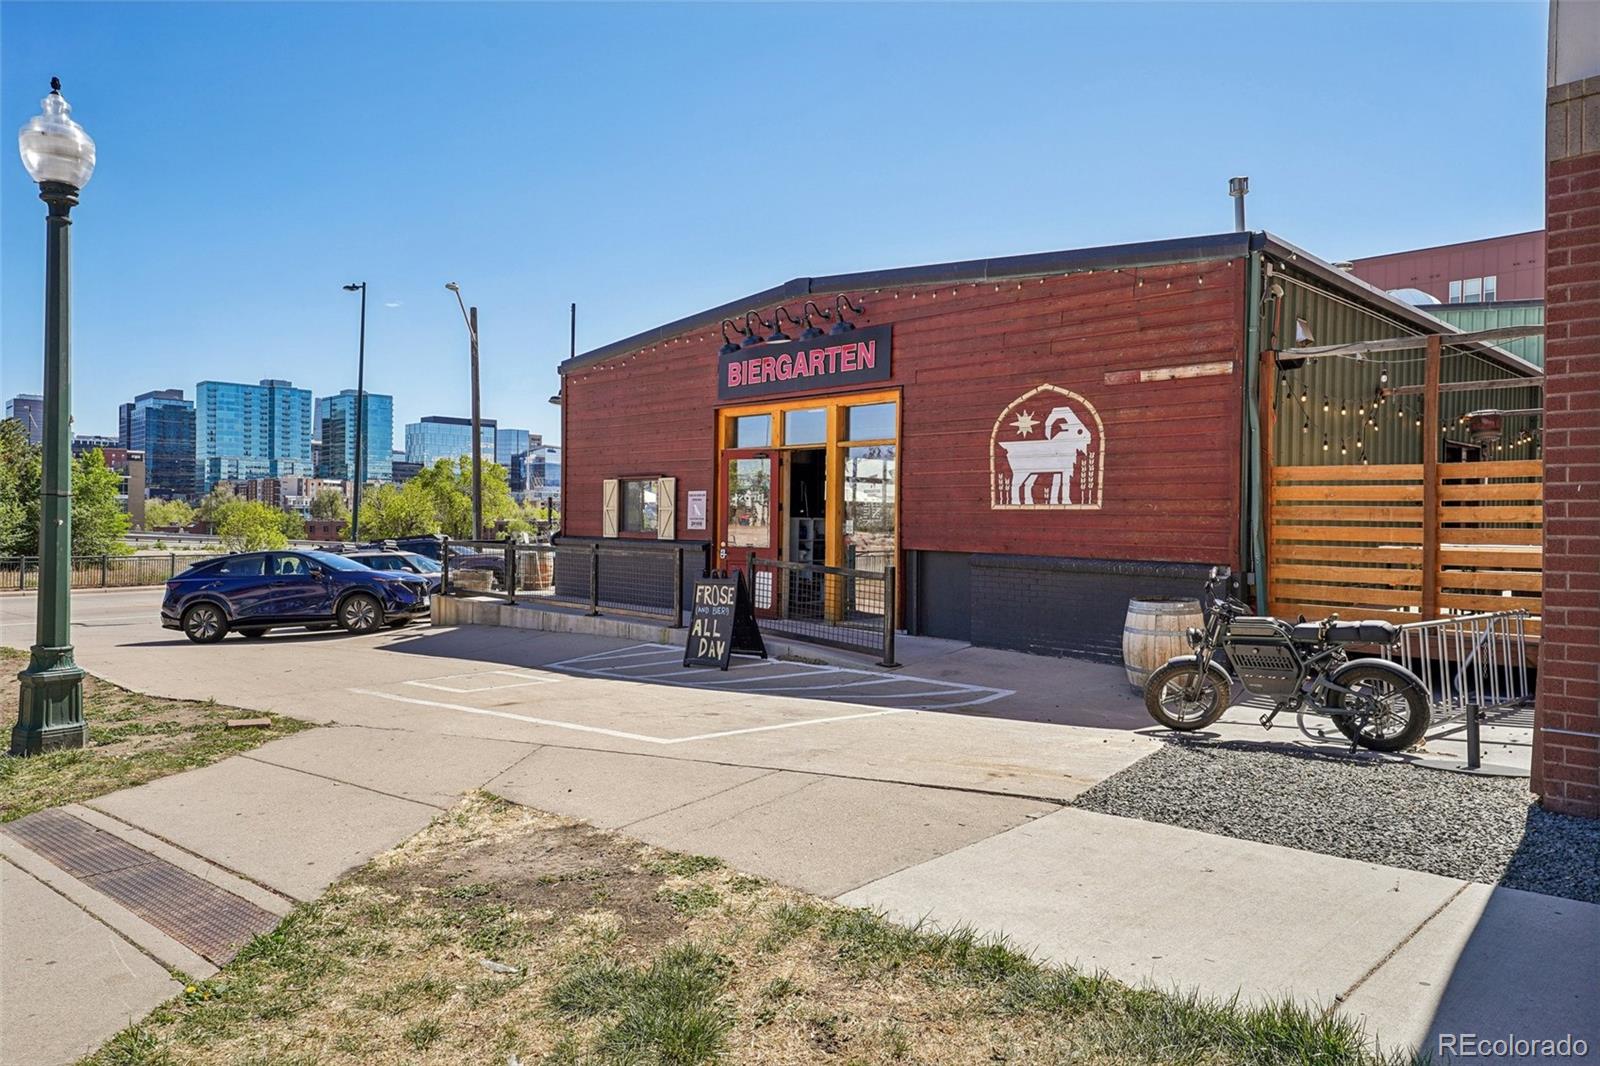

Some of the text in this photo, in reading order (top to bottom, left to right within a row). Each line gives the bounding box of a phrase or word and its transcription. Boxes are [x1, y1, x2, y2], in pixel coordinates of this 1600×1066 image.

[727, 340, 876, 388] BIERGARTEN
[695, 584, 735, 606] FROSE
[691, 618, 721, 637] ALL
[697, 637, 726, 661] DAY
